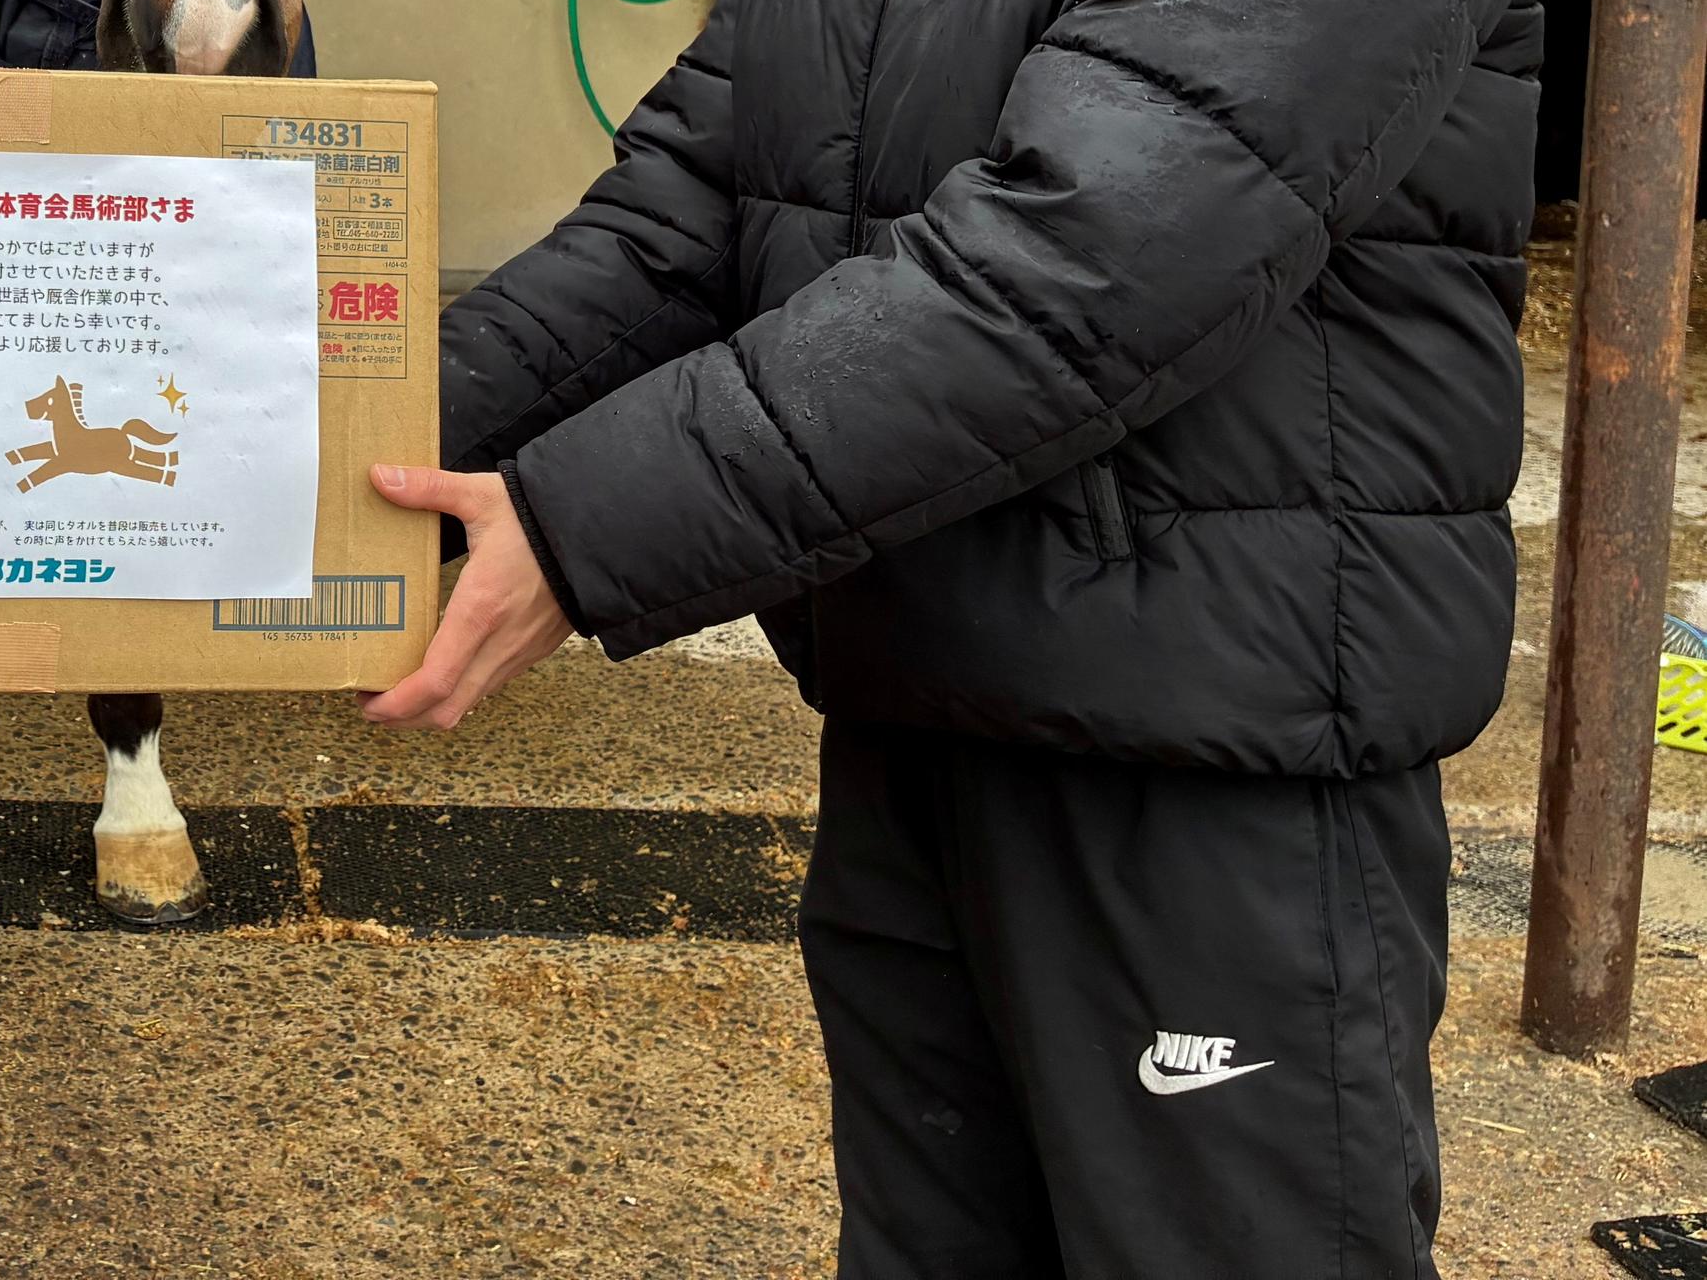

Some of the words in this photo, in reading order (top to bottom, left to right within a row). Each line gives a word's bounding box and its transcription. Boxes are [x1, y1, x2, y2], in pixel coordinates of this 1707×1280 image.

[265, 120, 362, 147] T34831
[328, 281, 399, 322] 危険
[322, 343, 343, 354] 危険
[24, 520, 226, 533] 実は同じタオルを普段は販売もしています。
[13, 535, 214, 548] その時に声をかけてもらえたら嬉しいです。
[262, 632, 278, 641] 145
[284, 632, 313, 641] 36735
[320, 632, 346, 641] 17841
[352, 632, 358, 641] 5
[1152, 1030, 1236, 1073] NIKE
